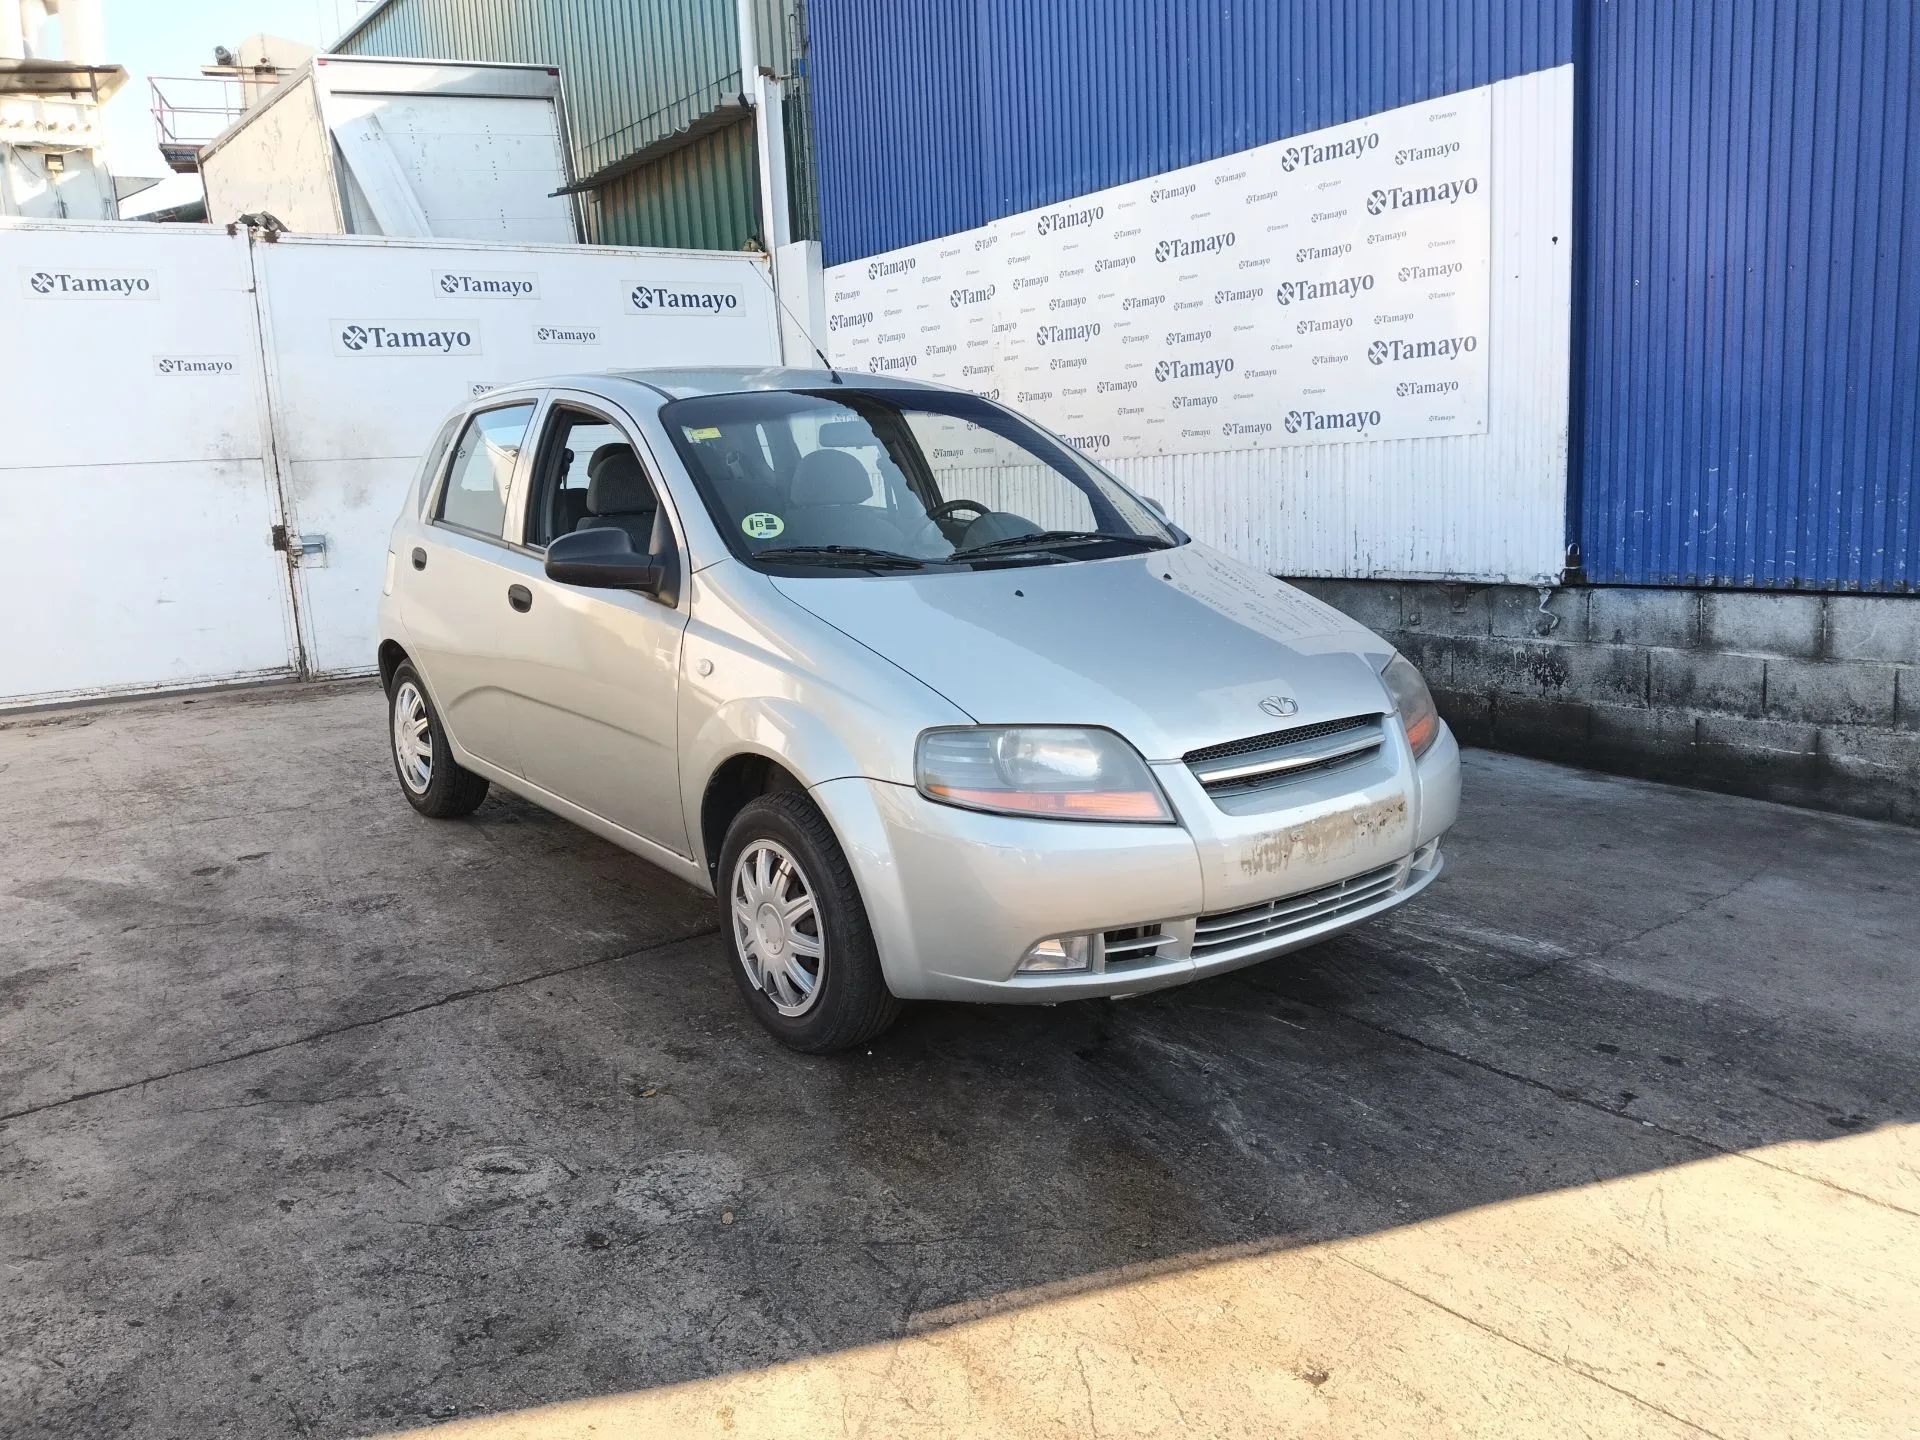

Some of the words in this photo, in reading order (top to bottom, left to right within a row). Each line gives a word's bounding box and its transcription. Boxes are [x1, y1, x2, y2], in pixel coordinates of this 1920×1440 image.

[1300, 132, 1380, 167] Tamayo
[1407, 141, 1460, 162] Tamayo
[1220, 171, 1247, 183] Tamayo
[1160, 183, 1196, 201] Tamayo
[1251, 190, 1279, 203] Tamayo
[1387, 177, 1478, 210] Tamayo
[1050, 206, 1104, 232] Tamayo
[1318, 209, 1348, 221] Tamayo
[1119, 228, 1142, 239] Tamayo
[1374, 230, 1407, 243] Tamayo
[1171, 231, 1236, 258] Tamayo
[1307, 243, 1352, 260] Tamayo
[878, 258, 916, 277] Tamayo
[1103, 256, 1136, 270] Tamayo
[1244, 257, 1271, 268] Tamayo
[1410, 262, 1463, 280] Tamayo
[55, 274, 150, 296] Tamayo
[459, 276, 533, 300] Tamayo
[1020, 275, 1049, 289] Tamayo
[1295, 274, 1375, 301] Tamayo
[653, 288, 737, 314] Tamayo
[1130, 294, 1166, 308] Tamayo
[1224, 287, 1264, 302] Tamayo
[1056, 296, 1087, 309] Tamayo
[1180, 300, 1204, 310] Tamayo
[837, 311, 874, 328] Tamayo
[1307, 317, 1353, 333] Tamayo
[1382, 313, 1414, 323] Tamayo
[549, 328, 596, 342] Tamayo
[883, 332, 906, 343] Tamayo
[1049, 322, 1101, 343] Tamayo
[1127, 334, 1150, 343] Tamayo
[1174, 330, 1212, 344] Tamayo
[368, 327, 471, 353] Tamayo
[932, 343, 957, 355] Tamayo
[1389, 335, 1477, 361] Tamayo
[173, 359, 233, 373] Tamayo
[879, 354, 917, 371] Tamayo
[1058, 357, 1087, 369] Tamayo
[1319, 354, 1349, 364] Tamayo
[1170, 357, 1235, 379] Tamayo
[1250, 369, 1277, 378] Tamayo
[1105, 380, 1138, 393] Tamayo
[1408, 381, 1459, 395] Tamayo
[1024, 391, 1053, 402] Tamayo
[1180, 395, 1218, 408] Tamayo
[1122, 407, 1145, 416] Tamayo
[1302, 410, 1381, 432] Tamayo
[1187, 429, 1211, 437] Tamayo
[1232, 423, 1272, 435] Tamayo
[940, 448, 964, 458] Tamayo
[755, 520, 764, 528] B
